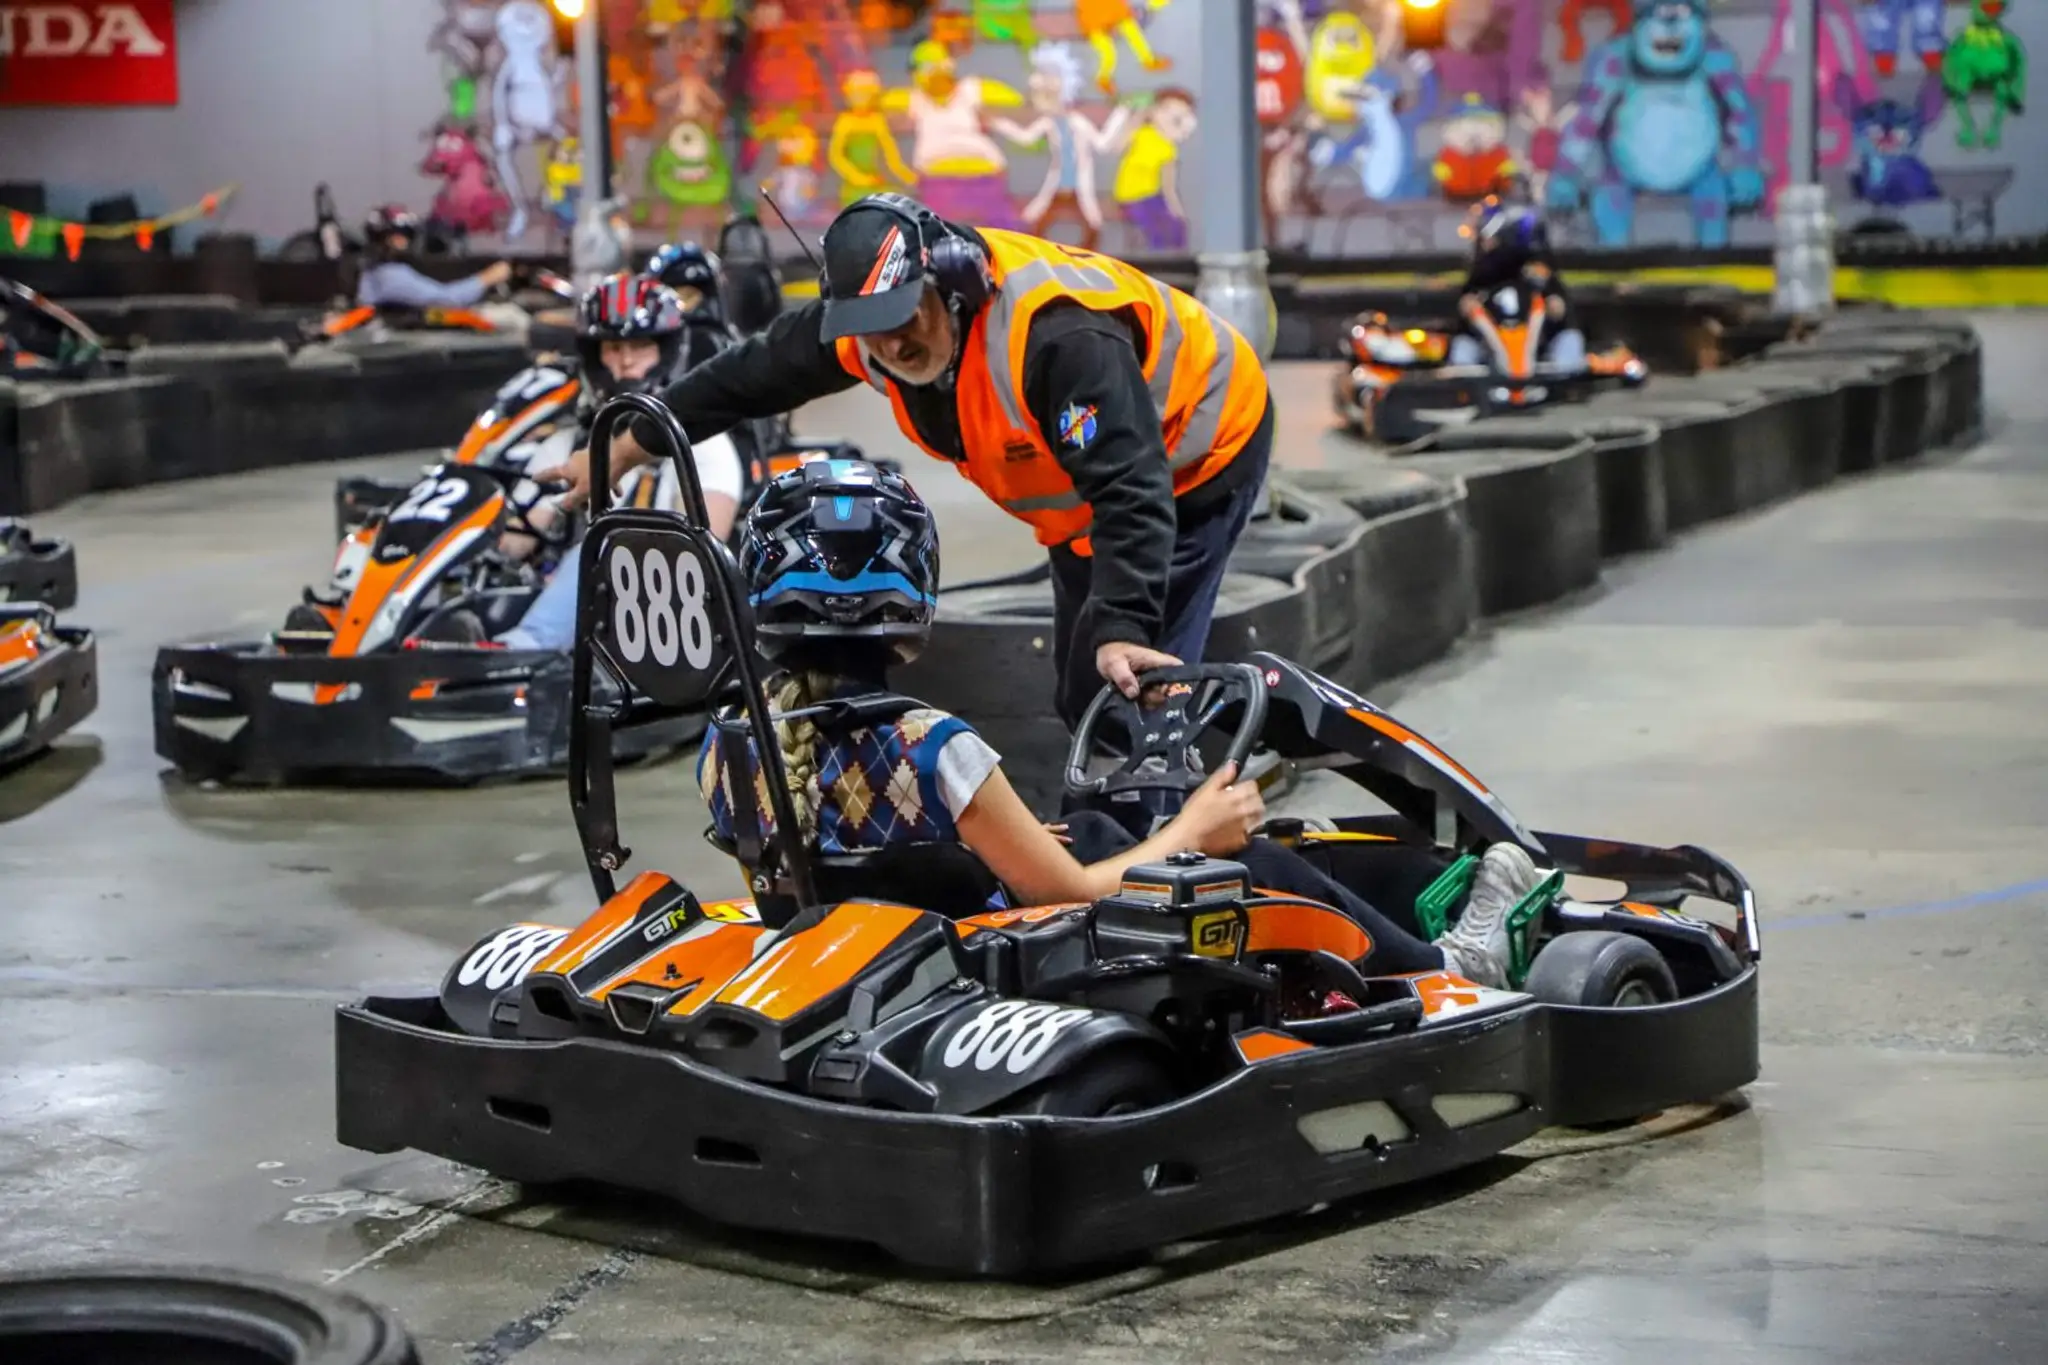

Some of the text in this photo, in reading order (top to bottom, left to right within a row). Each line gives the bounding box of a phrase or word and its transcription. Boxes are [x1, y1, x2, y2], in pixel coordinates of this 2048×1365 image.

[0, 5, 165, 57] DA
[389, 478, 469, 522] 22
[611, 545, 712, 670] 888
[944, 1001, 1093, 1074] 888
